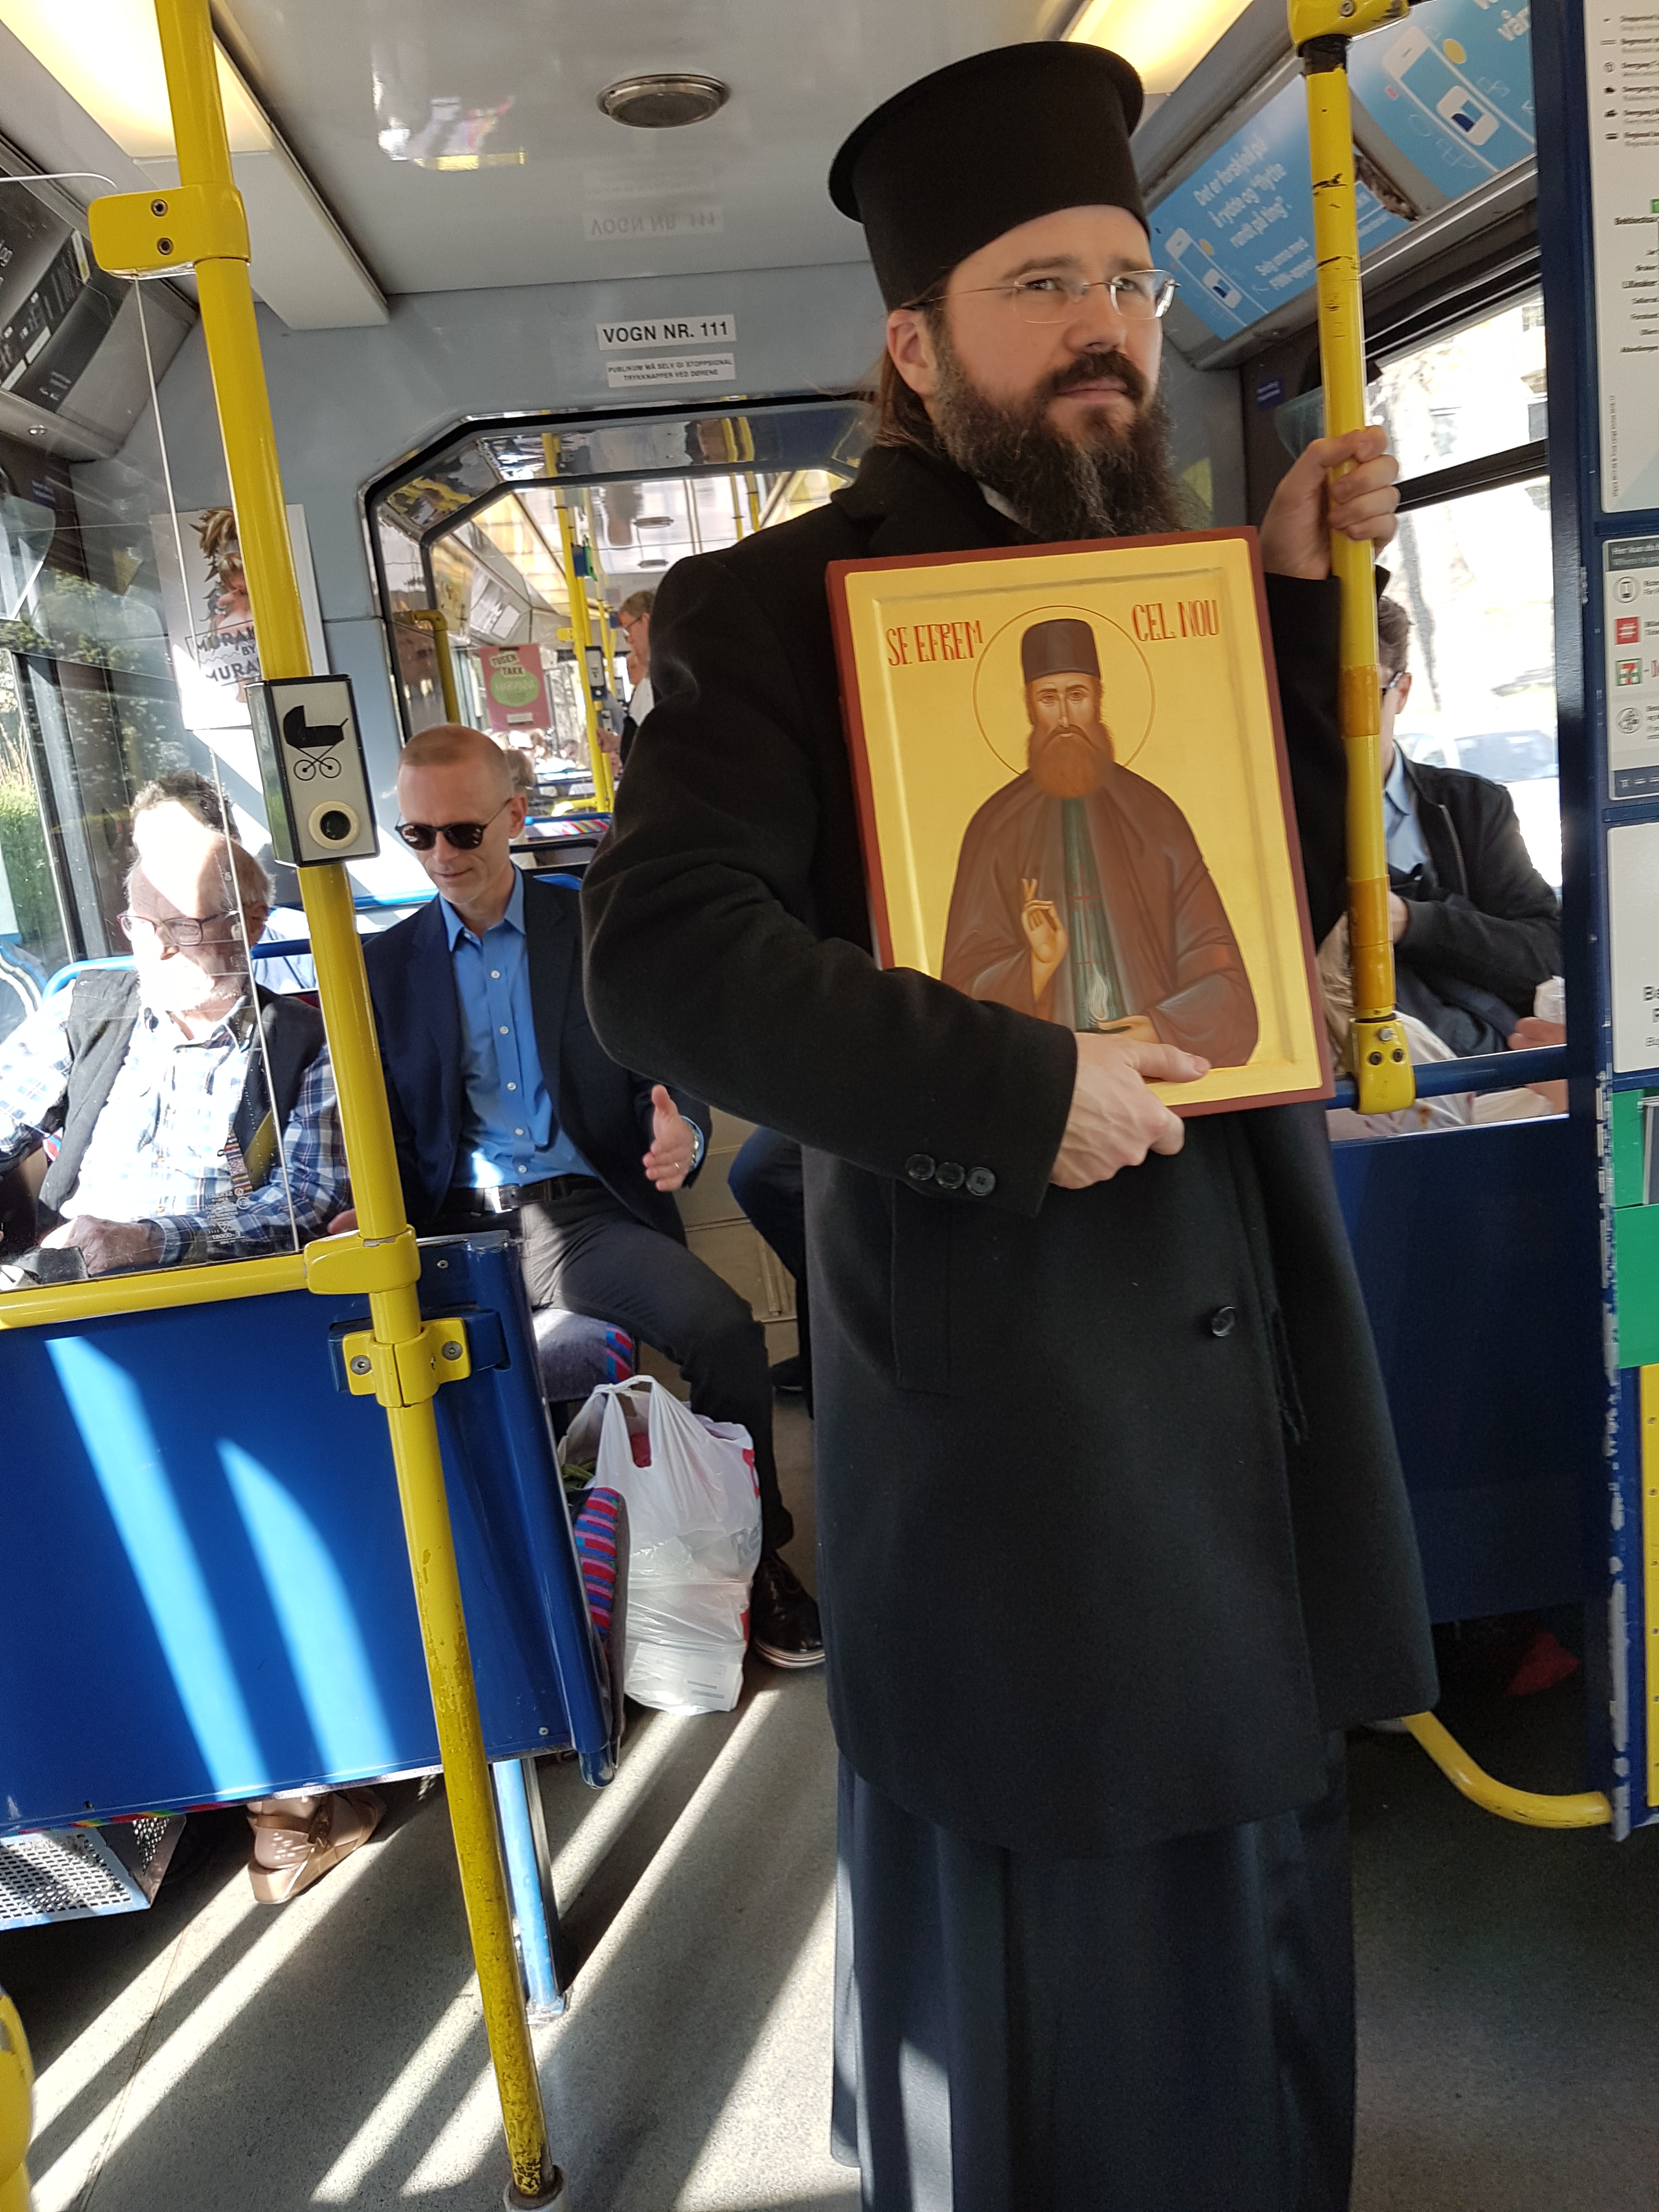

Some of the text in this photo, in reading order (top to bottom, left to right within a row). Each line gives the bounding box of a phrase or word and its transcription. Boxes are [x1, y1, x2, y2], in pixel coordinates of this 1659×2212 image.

[603, 321, 727, 343] VOGN NR. 111
[1132, 600, 1220, 642] CEL NOU
[241, 644, 256, 656] BY
[913, 620, 984, 663] EFREM
